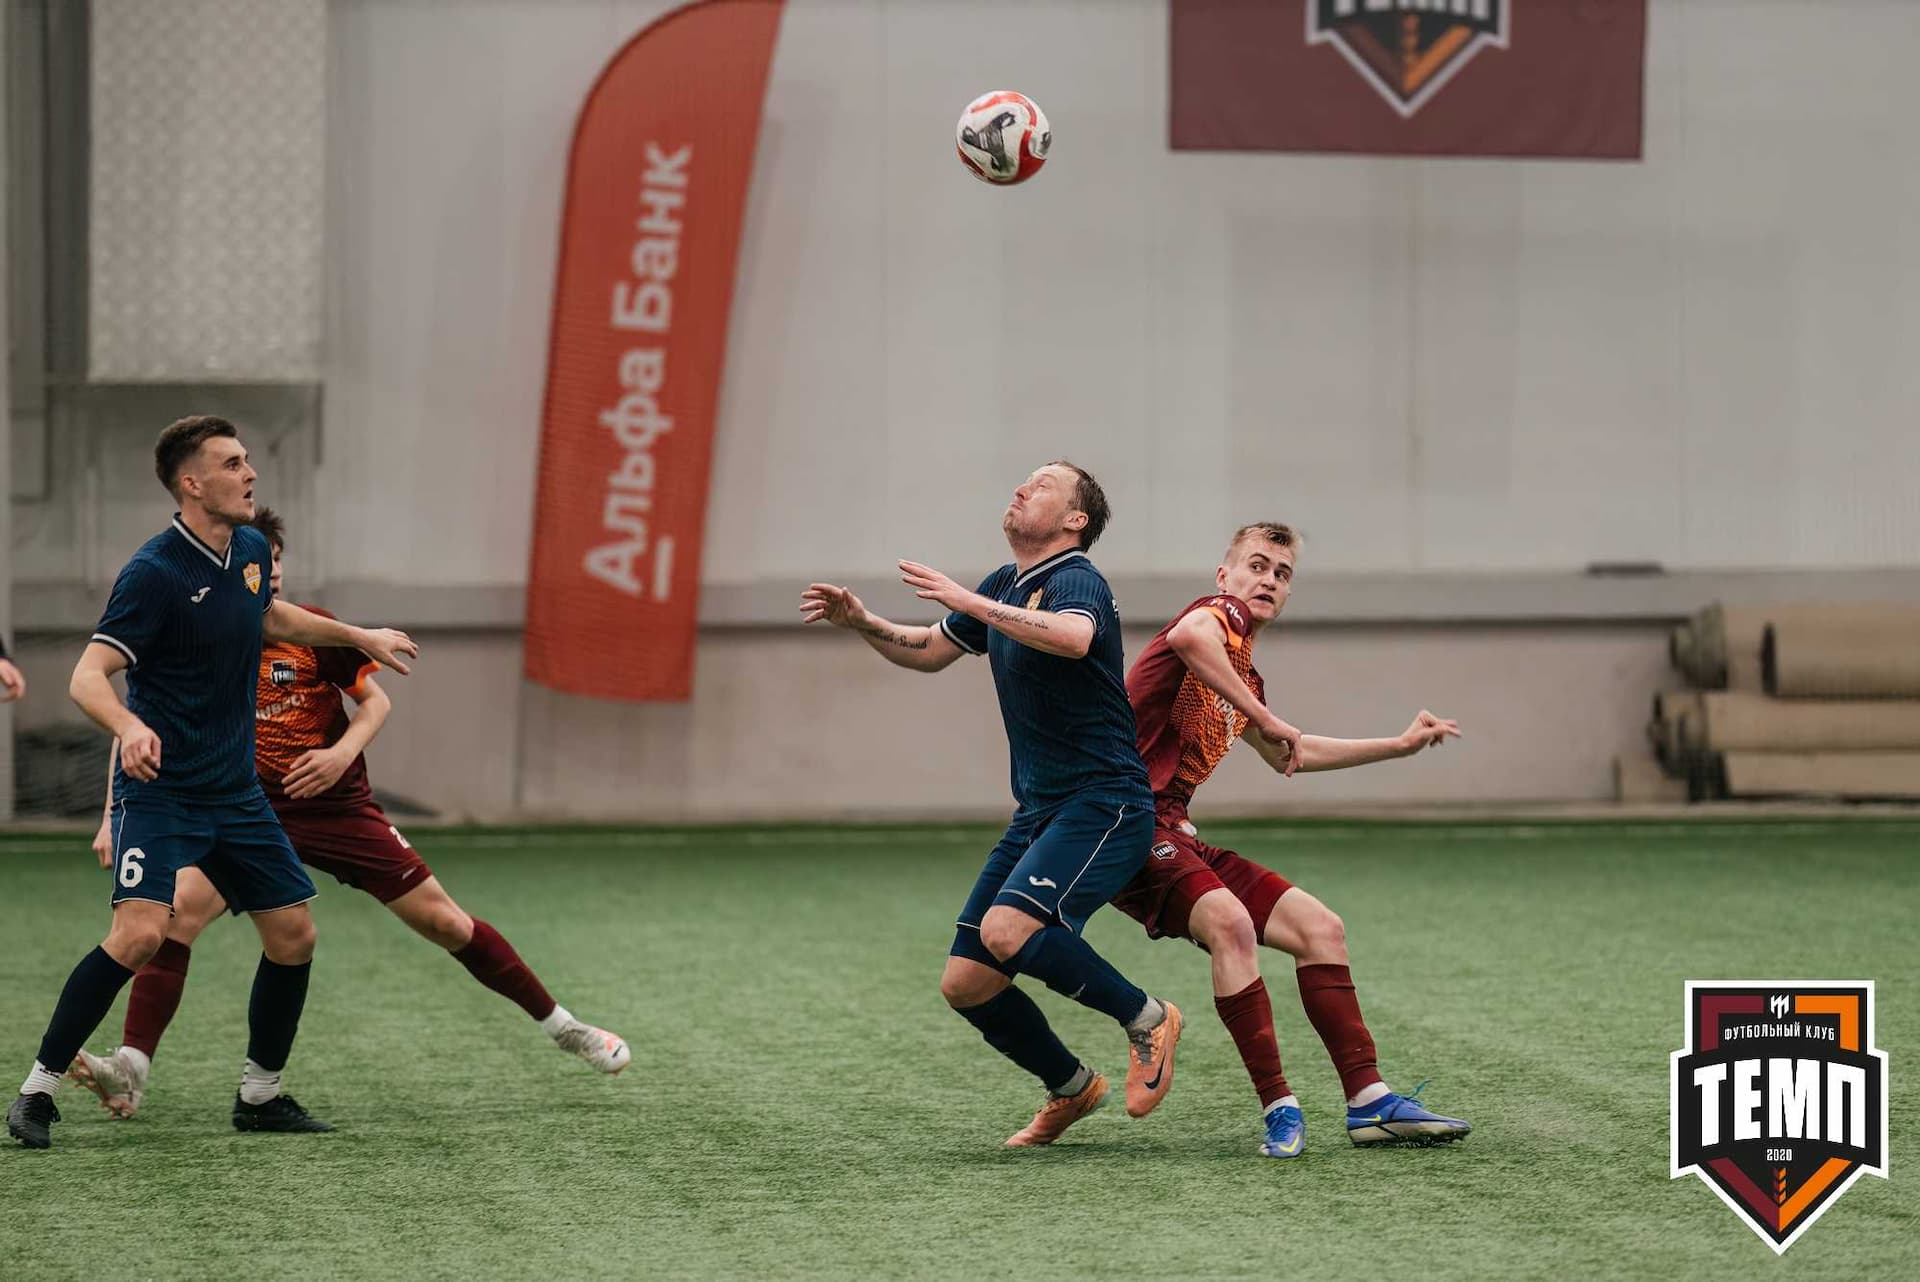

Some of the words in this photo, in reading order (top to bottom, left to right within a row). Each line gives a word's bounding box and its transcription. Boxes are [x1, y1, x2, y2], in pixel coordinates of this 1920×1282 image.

[610, 141, 694, 332] Банк
[584, 346, 674, 597] Альфа
[119, 847, 146, 888] 6
